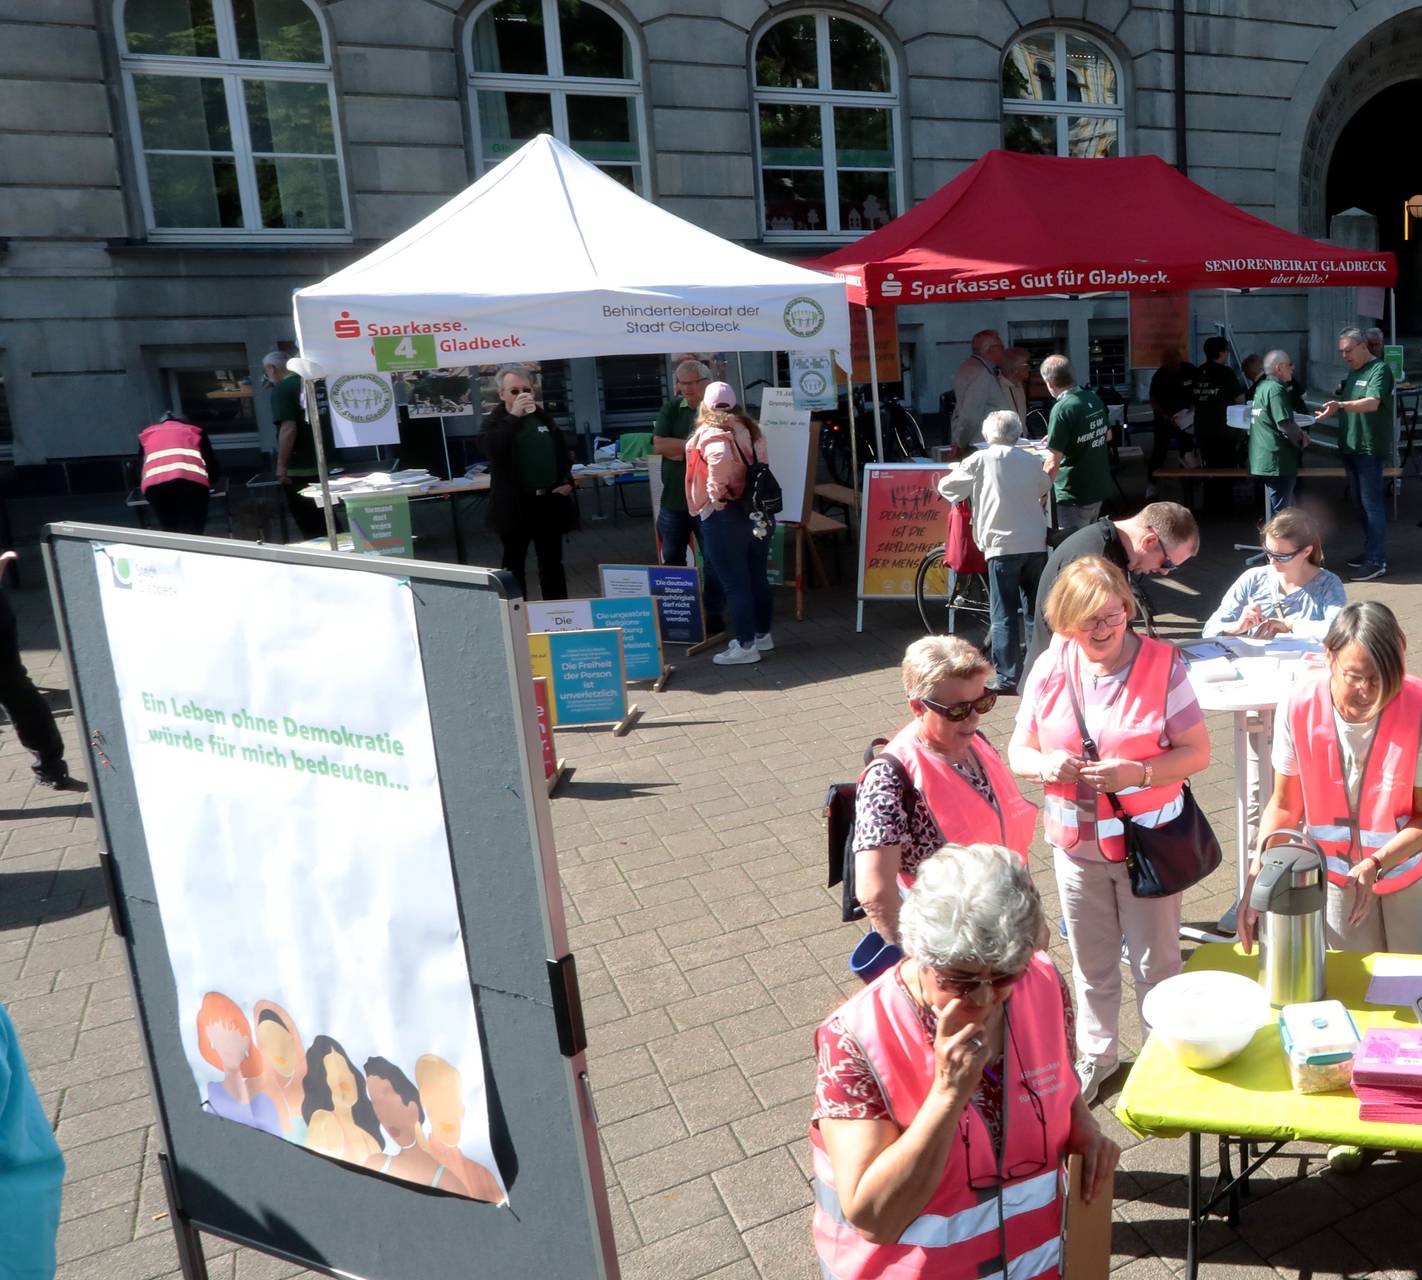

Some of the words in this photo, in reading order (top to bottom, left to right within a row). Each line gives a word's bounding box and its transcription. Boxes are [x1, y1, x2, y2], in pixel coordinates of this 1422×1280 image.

[1205, 258, 1320, 272] SENIORENBEIRAT
[1321, 260, 1387, 272] GLADBECK
[910, 278, 1016, 299] Sparkasse.
[1021, 273, 1053, 288] Gut
[1056, 270, 1084, 286] für
[1088, 270, 1171, 285] Gladbeck.
[1270, 273, 1294, 284] aber
[602, 305, 732, 317] Behindertenbeirat
[736, 305, 760, 317] der
[367, 321, 468, 337] Sparkasse.
[626, 321, 665, 333] Stadt
[669, 320, 741, 333] Gladbeck
[394, 337, 417, 359] 4
[440, 335, 526, 353] Gladbeck.
[555, 617, 572, 625] Die
[561, 662, 577, 671] Die
[578, 661, 612, 669] Freiheit
[563, 672, 579, 680] der
[580, 671, 612, 679] Person
[141, 691, 167, 715] Ein
[171, 697, 227, 726] Leben
[231, 708, 278, 736] ohne
[283, 716, 405, 757] Demokratie
[148, 727, 204, 753] würde
[208, 737, 236, 759] für
[241, 743, 287, 769] mich
[291, 749, 410, 792] bedeuten...
